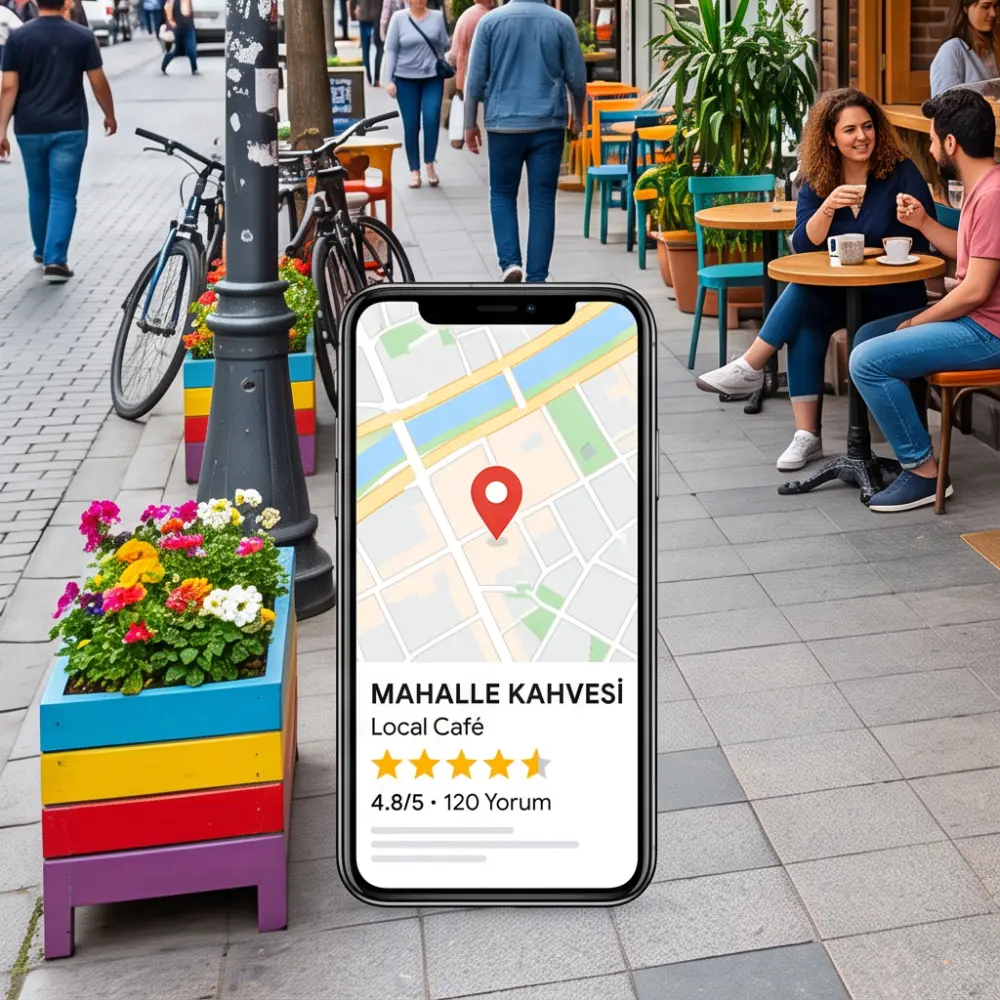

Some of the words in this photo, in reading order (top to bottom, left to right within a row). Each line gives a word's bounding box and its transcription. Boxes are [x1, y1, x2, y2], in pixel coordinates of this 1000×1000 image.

[371, 683, 500, 704] MAHALLE
[509, 678, 623, 704] KAHVESİ
[371, 717, 427, 736] Local
[433, 717, 485, 736] Café
[371, 793, 424, 811] 4.8/5
[444, 793, 479, 811] 120
[485, 793, 552, 811] Yorum
